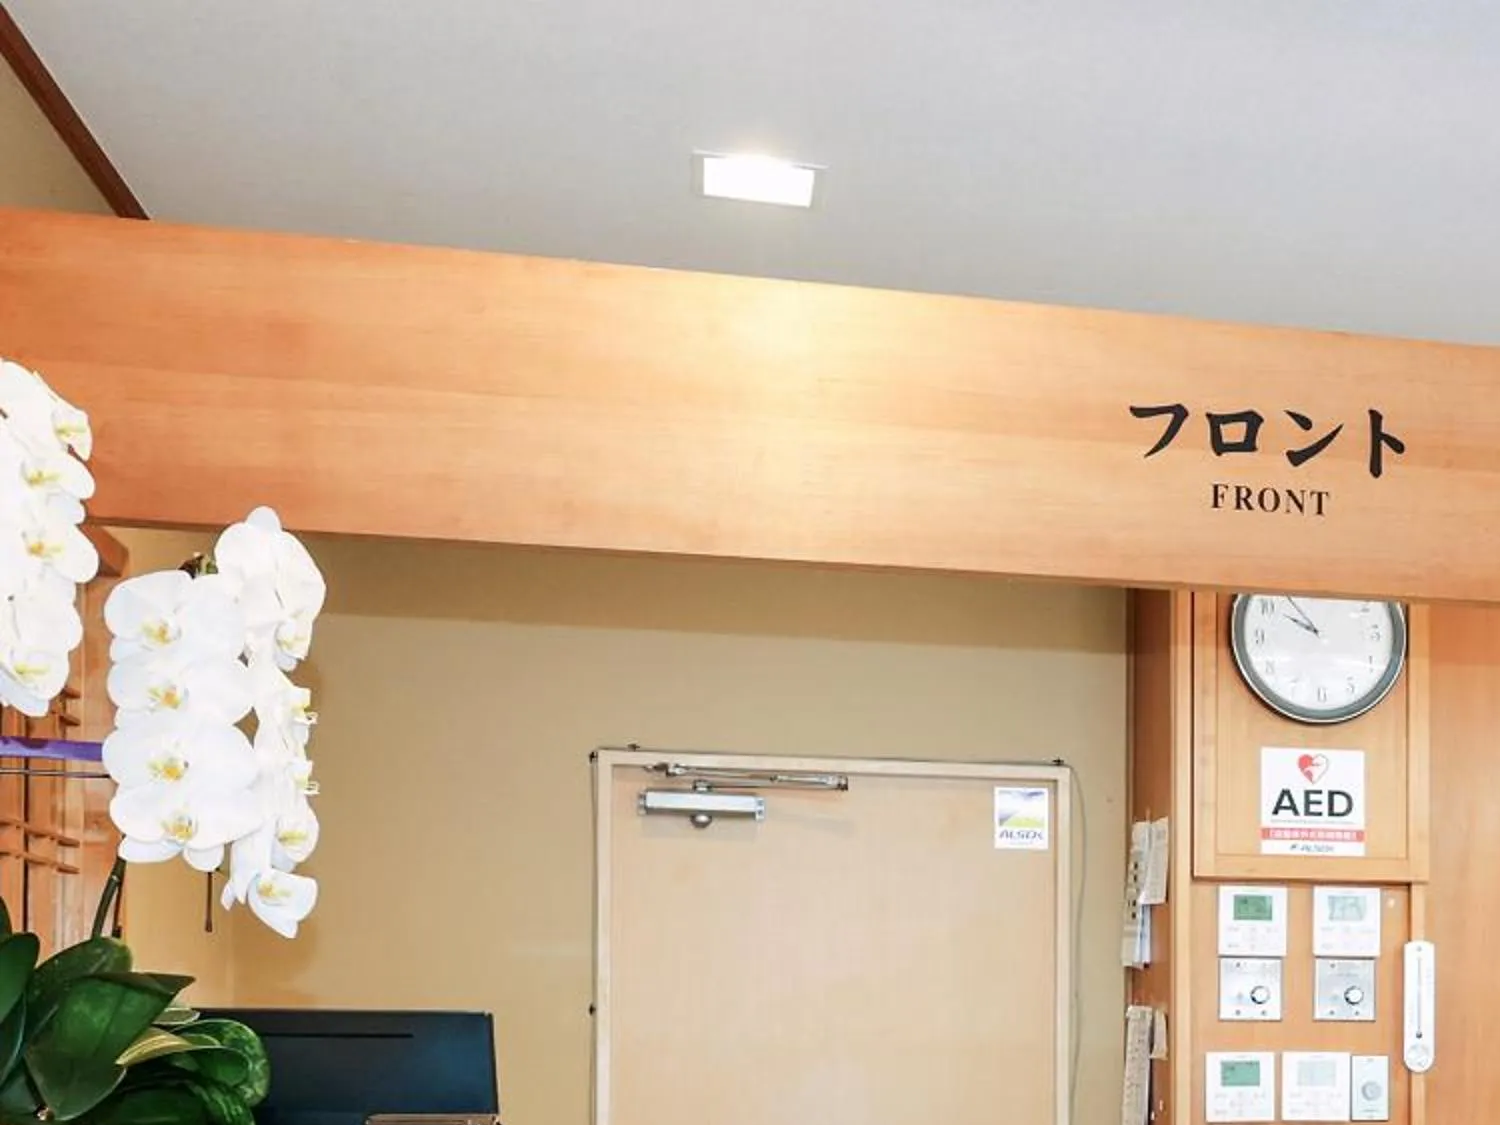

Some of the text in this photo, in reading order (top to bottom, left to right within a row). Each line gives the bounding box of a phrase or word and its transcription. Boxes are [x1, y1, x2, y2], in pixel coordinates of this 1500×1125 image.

[1129, 403, 1405, 479] フロント
[1210, 484, 1329, 516] FRONT
[1271, 789, 1354, 817] AED
